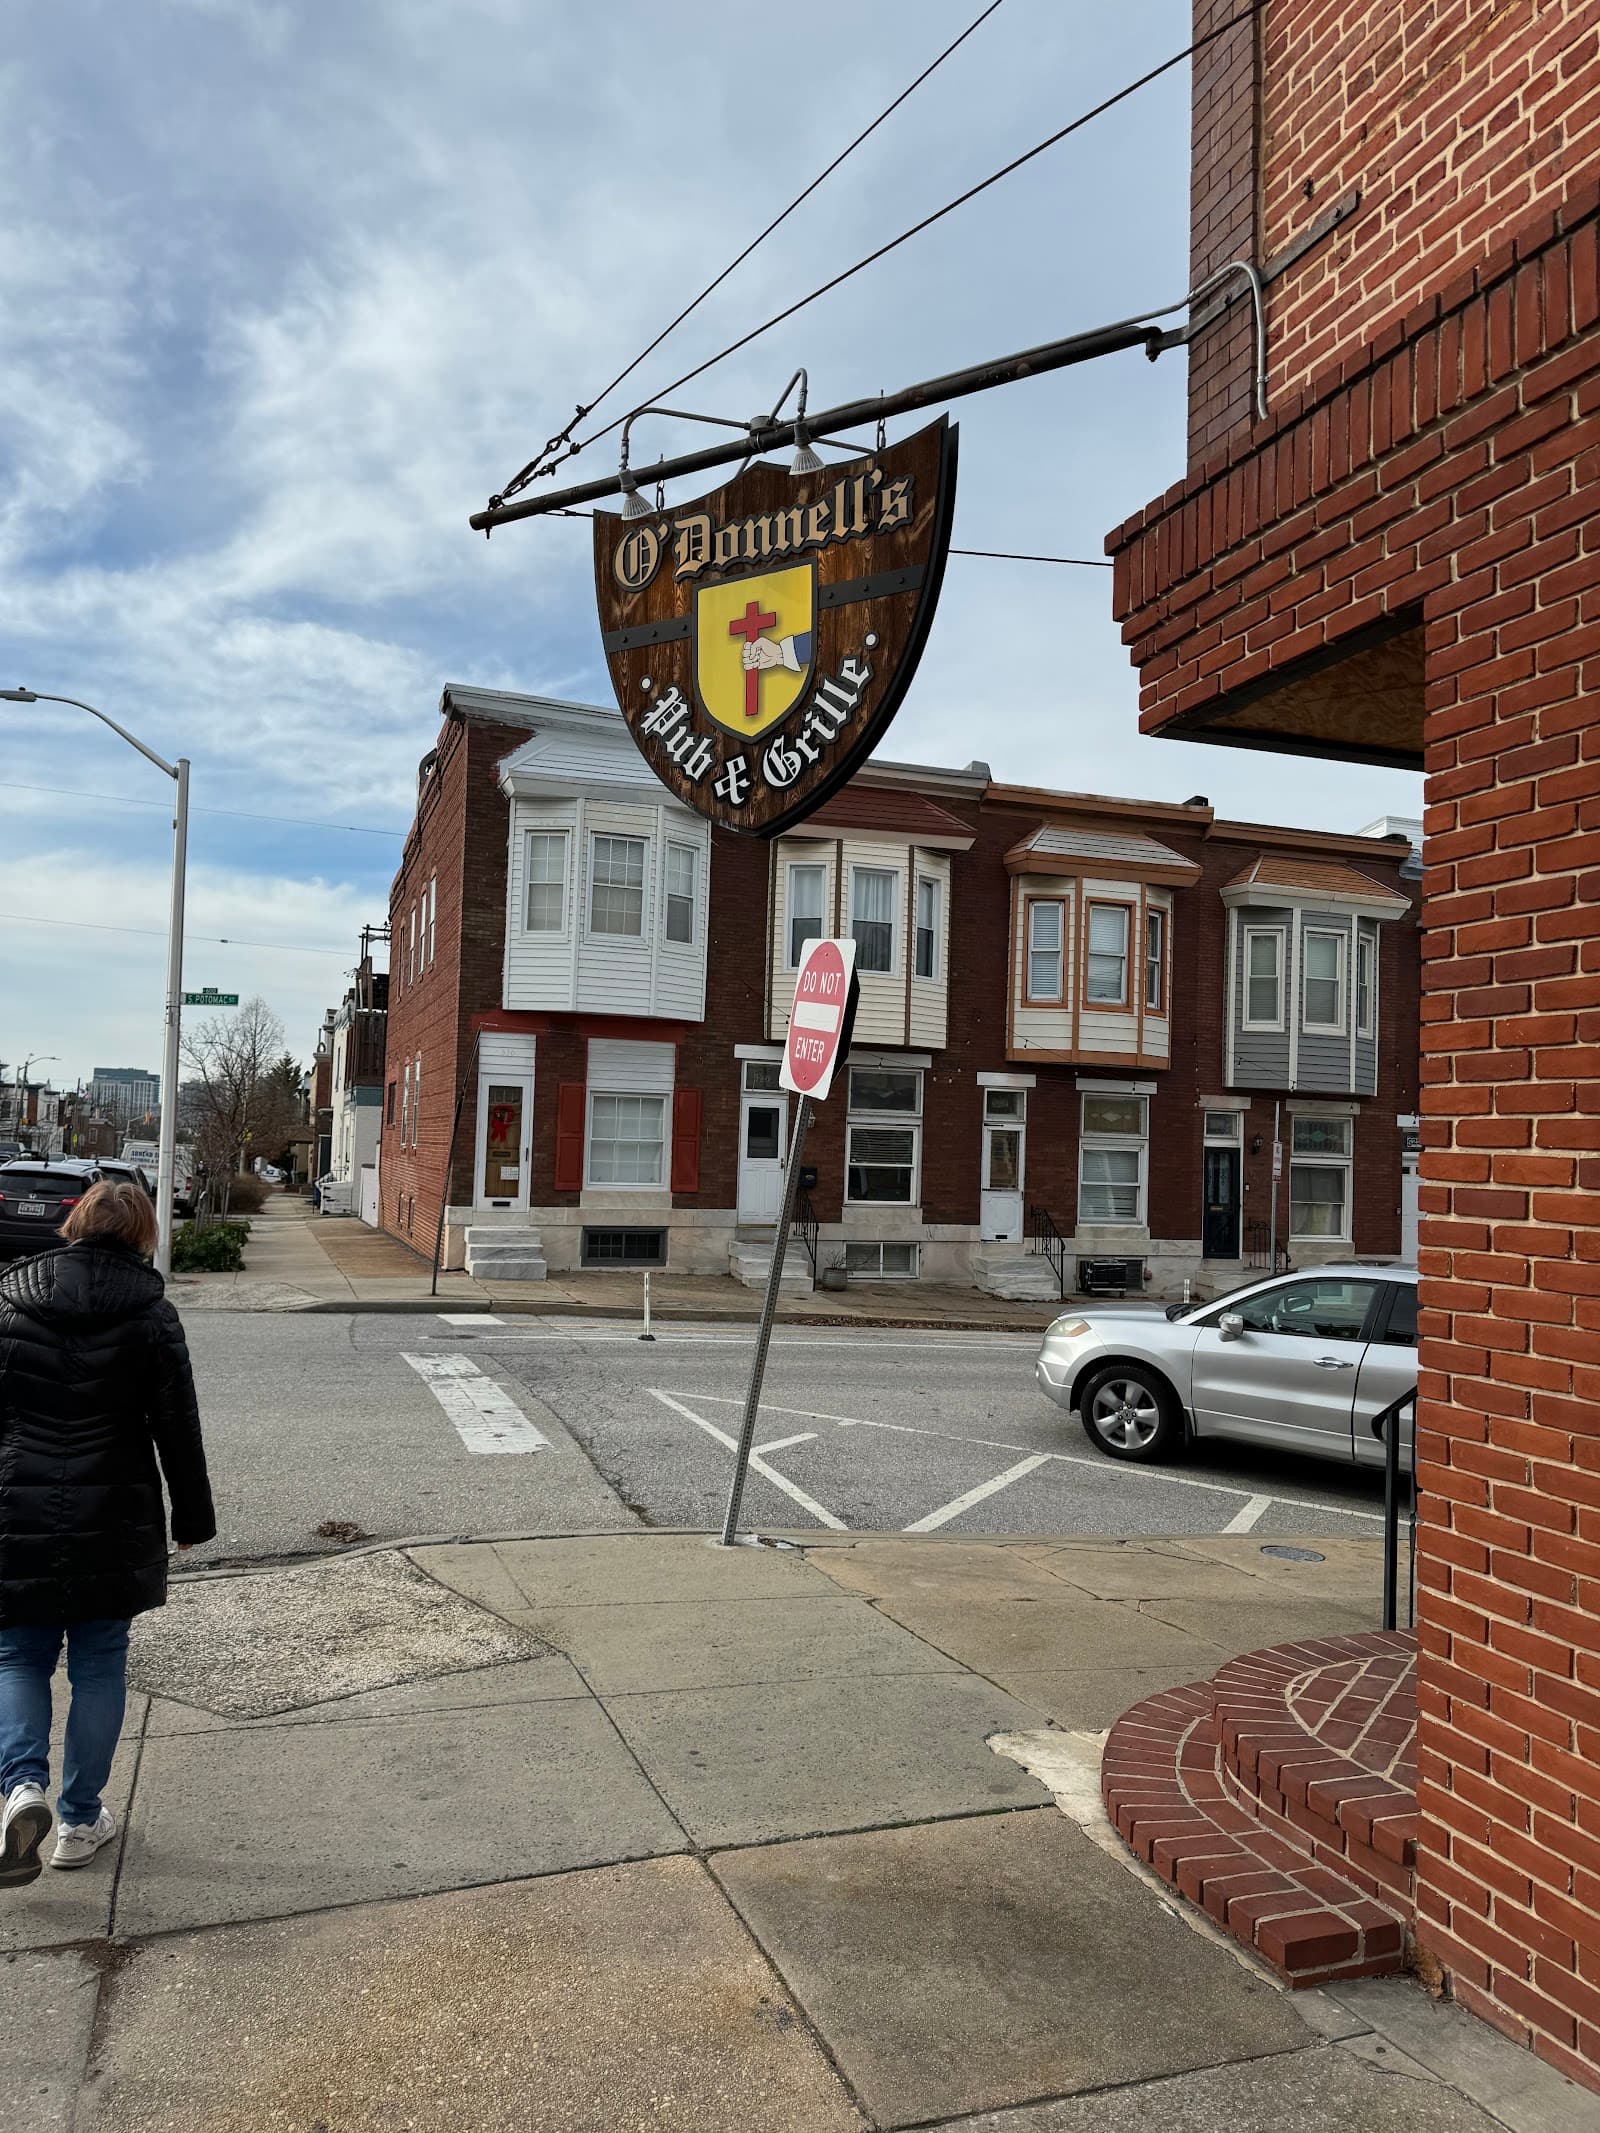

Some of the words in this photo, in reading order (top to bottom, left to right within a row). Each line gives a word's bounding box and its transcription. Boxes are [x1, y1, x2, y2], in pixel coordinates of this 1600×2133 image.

[614, 468, 912, 588] O'Donnell's
[641, 686, 713, 781] Pub
[714, 756, 751, 805] &
[762, 657, 869, 787] Grille
[803, 971, 817, 992] DO
[820, 972, 842, 996] NOT
[195, 994, 228, 1004] POTOMAC
[795, 1037, 825, 1063] ENTER
